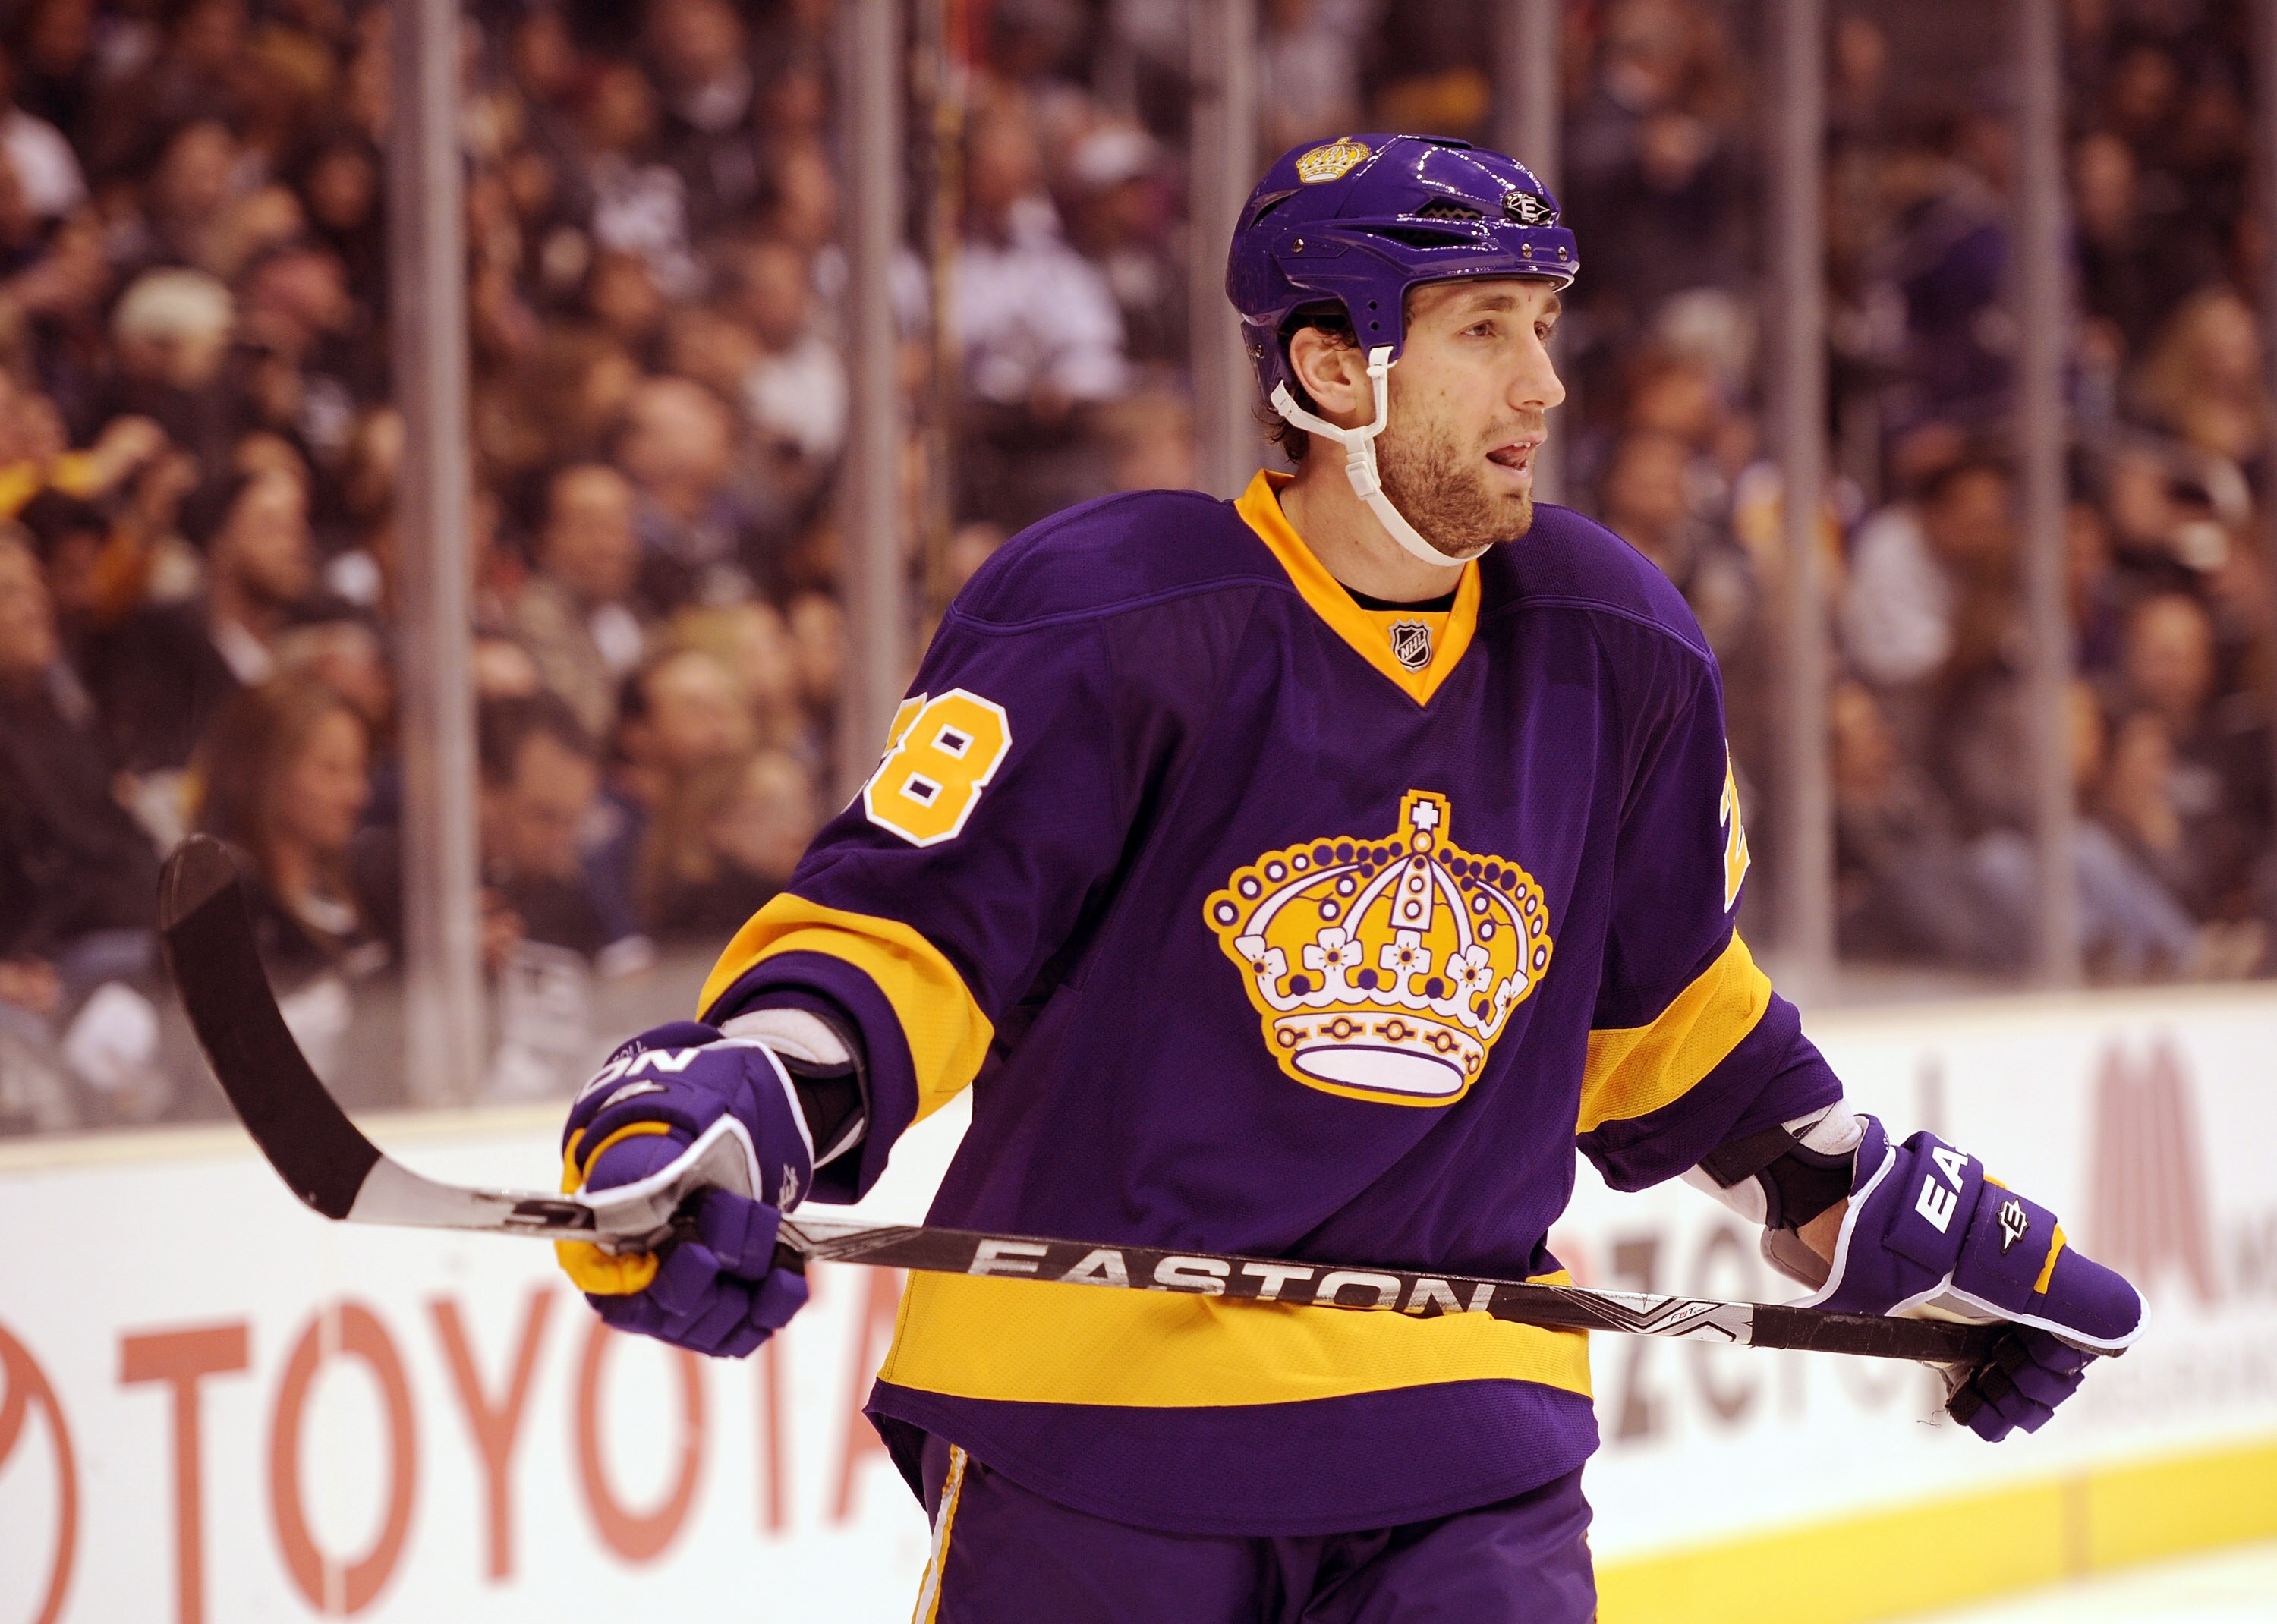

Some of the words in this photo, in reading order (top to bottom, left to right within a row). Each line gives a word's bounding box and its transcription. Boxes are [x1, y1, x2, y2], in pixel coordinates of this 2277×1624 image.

[1400, 633, 1422, 659] NHL
[864, 688, 1013, 848] 8
[1914, 1142, 1968, 1234] EA
[967, 1238, 1496, 1315] EASTON
